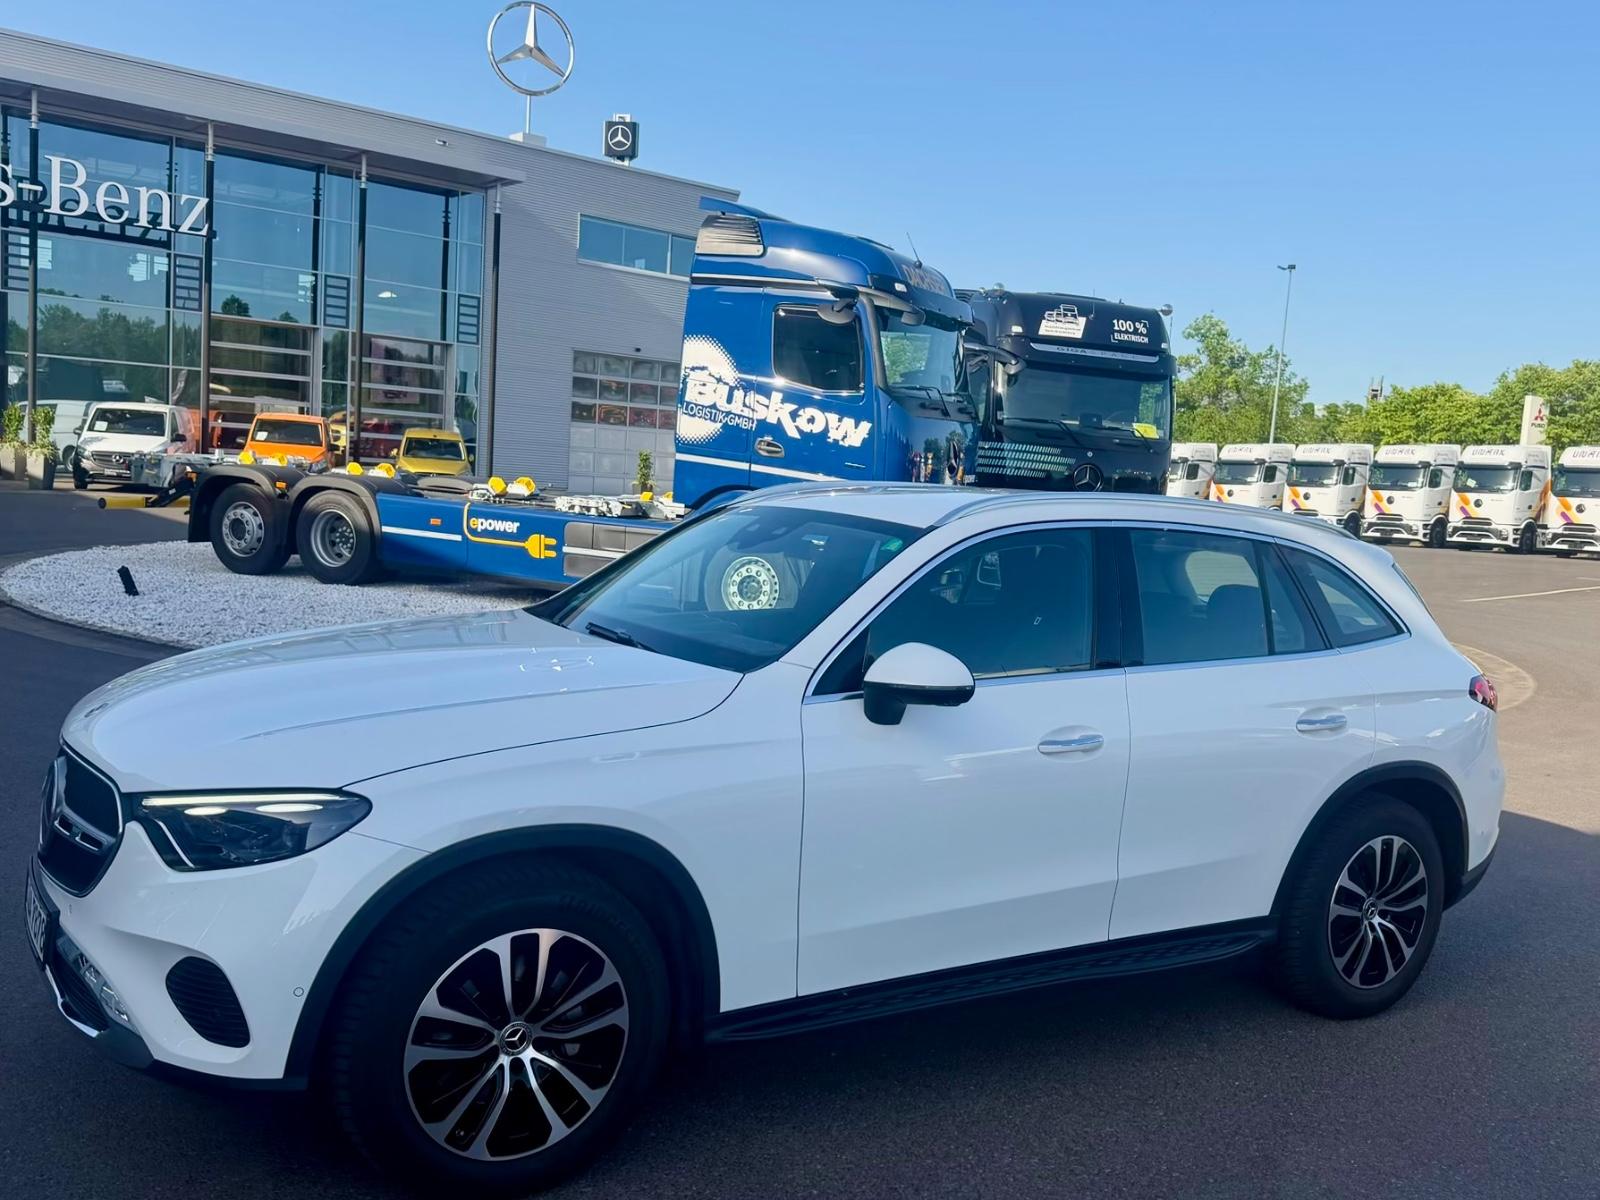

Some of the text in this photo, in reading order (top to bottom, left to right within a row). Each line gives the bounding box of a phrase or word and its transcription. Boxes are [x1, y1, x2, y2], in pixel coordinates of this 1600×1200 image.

[1113, 319, 1148, 335] 100 %
[1114, 333, 1149, 343] ELEKTRISCH
[470, 518, 520, 533] epower
